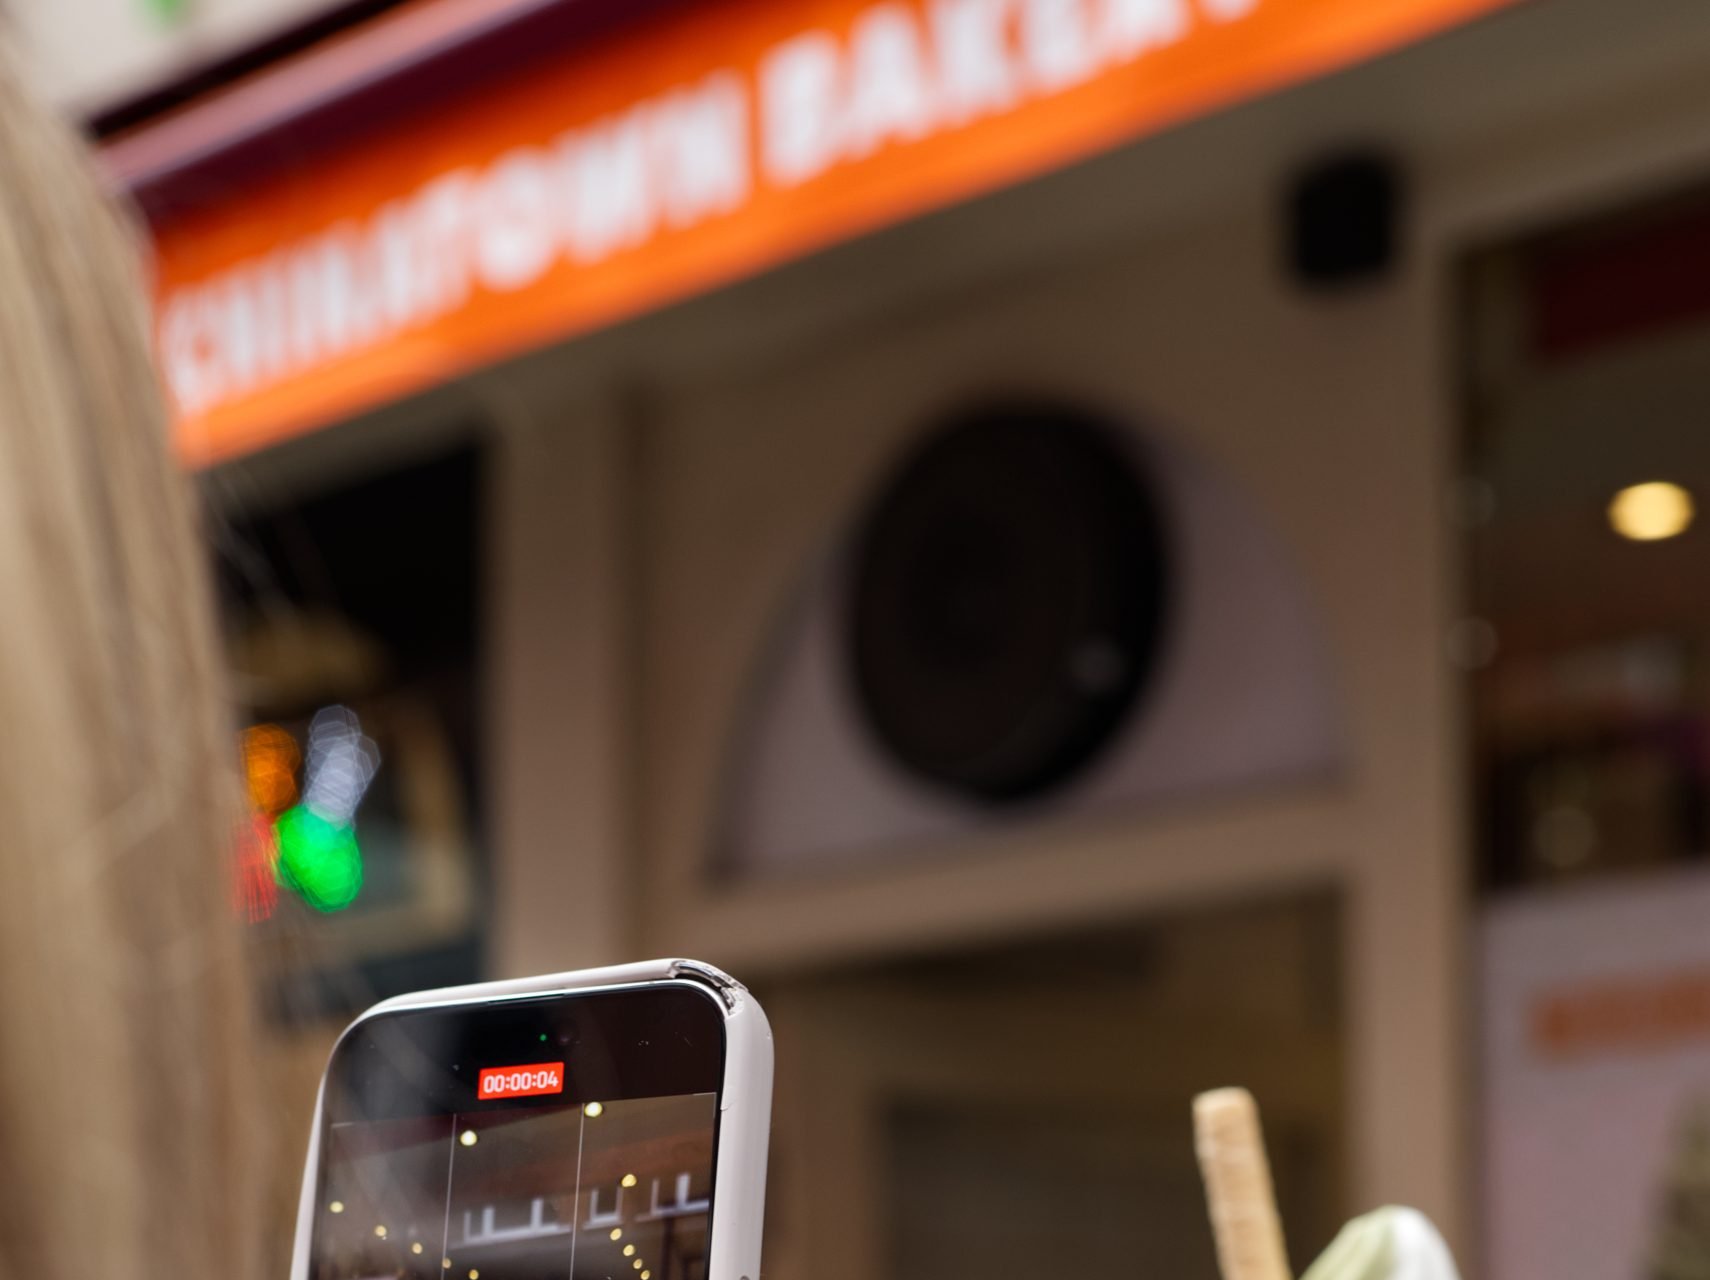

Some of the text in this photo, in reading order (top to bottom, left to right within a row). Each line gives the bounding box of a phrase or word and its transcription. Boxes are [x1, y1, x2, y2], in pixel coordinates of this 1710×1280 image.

[163, 0, 1258, 412] CHINATOWN BAKE
[483, 1071, 559, 1093] 00:00:04
